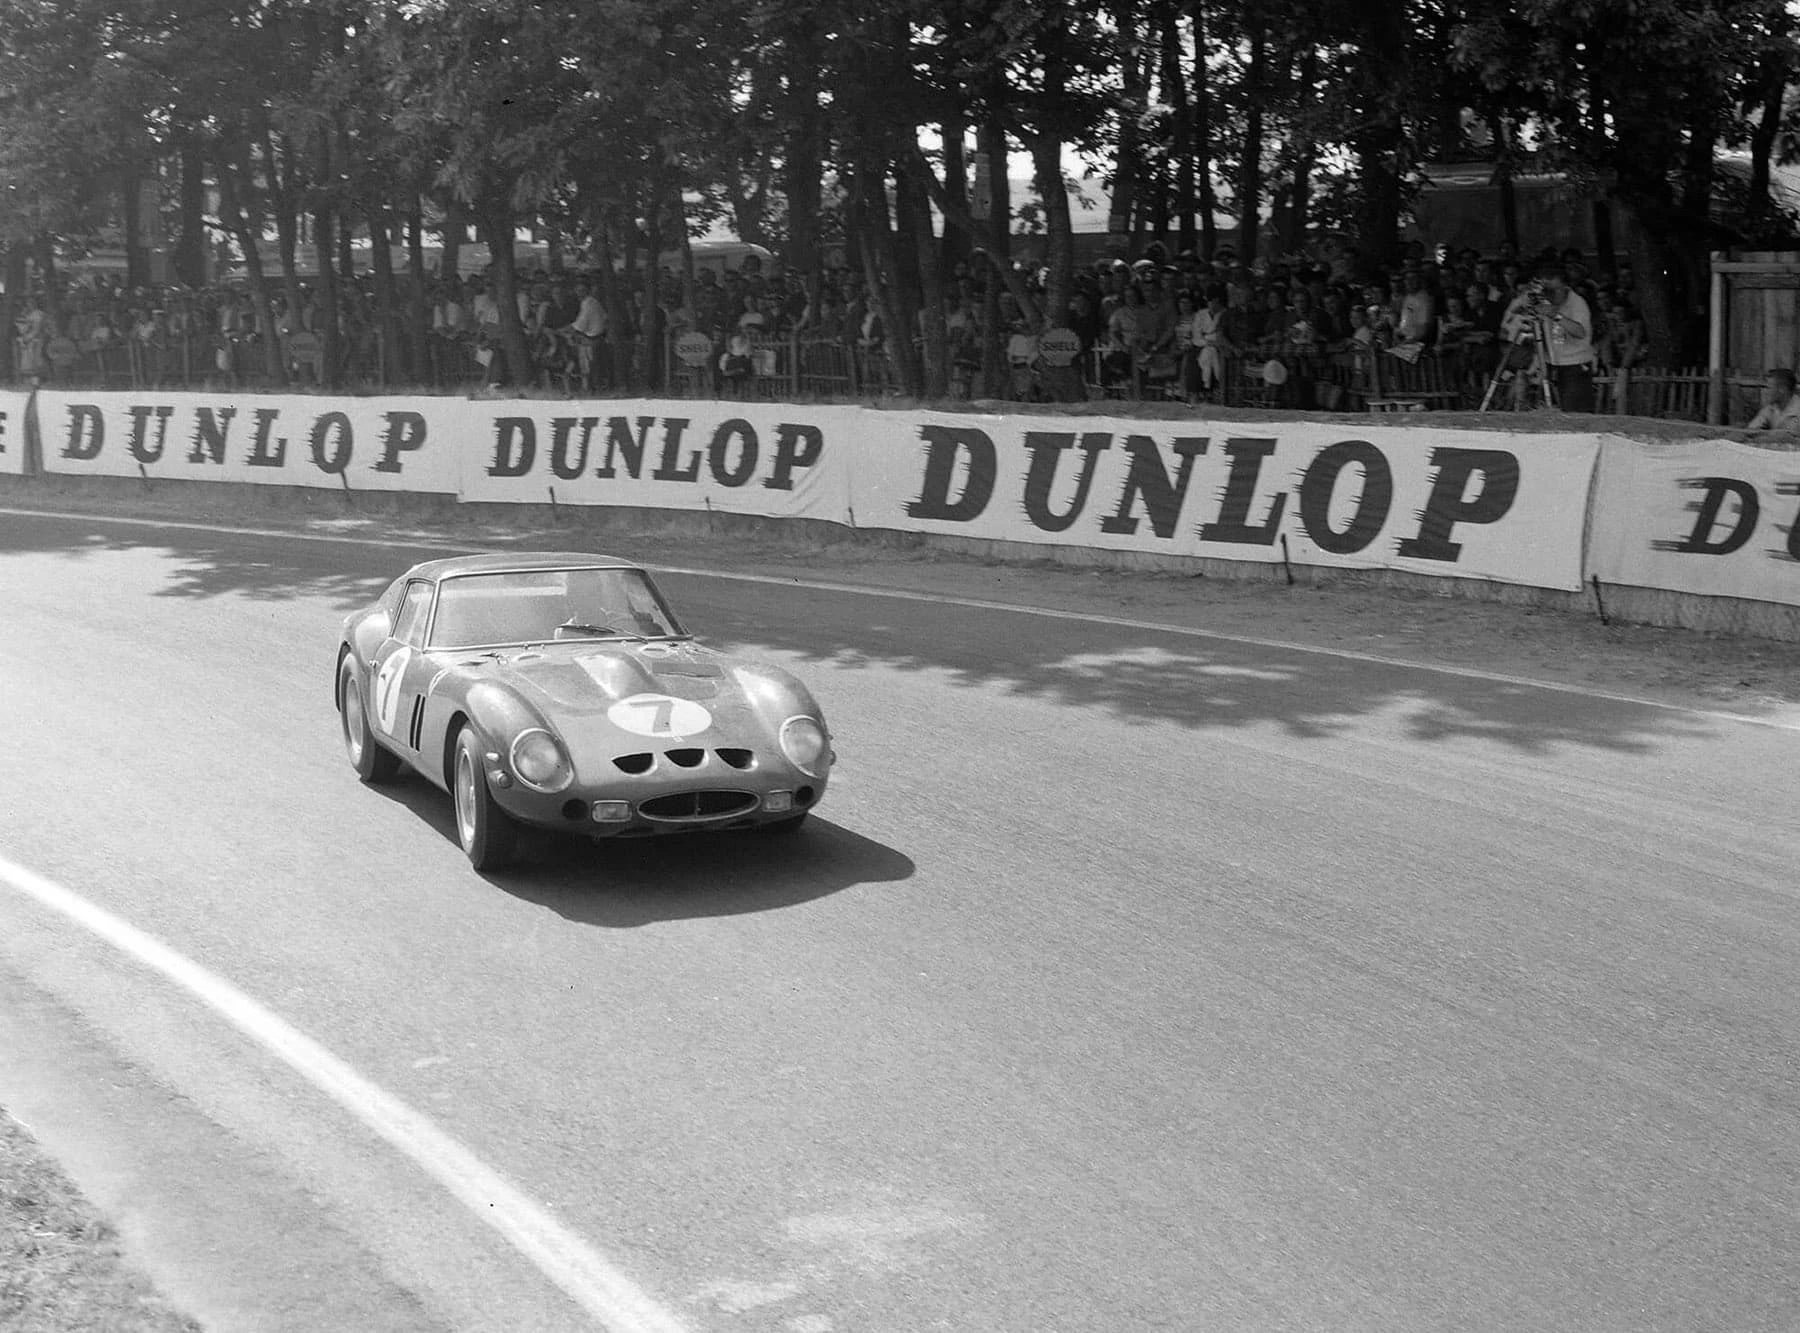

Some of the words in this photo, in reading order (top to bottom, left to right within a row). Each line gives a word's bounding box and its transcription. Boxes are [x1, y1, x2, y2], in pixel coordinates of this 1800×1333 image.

[1042, 342, 1078, 353] SHELL
[62, 404, 427, 473] DUNLOP
[485, 416, 823, 491] DUNLOP
[901, 424, 1520, 562] DUNLOP
[1650, 477, 1800, 562] D
[382, 655, 406, 721] 7
[628, 701, 673, 733] 7
